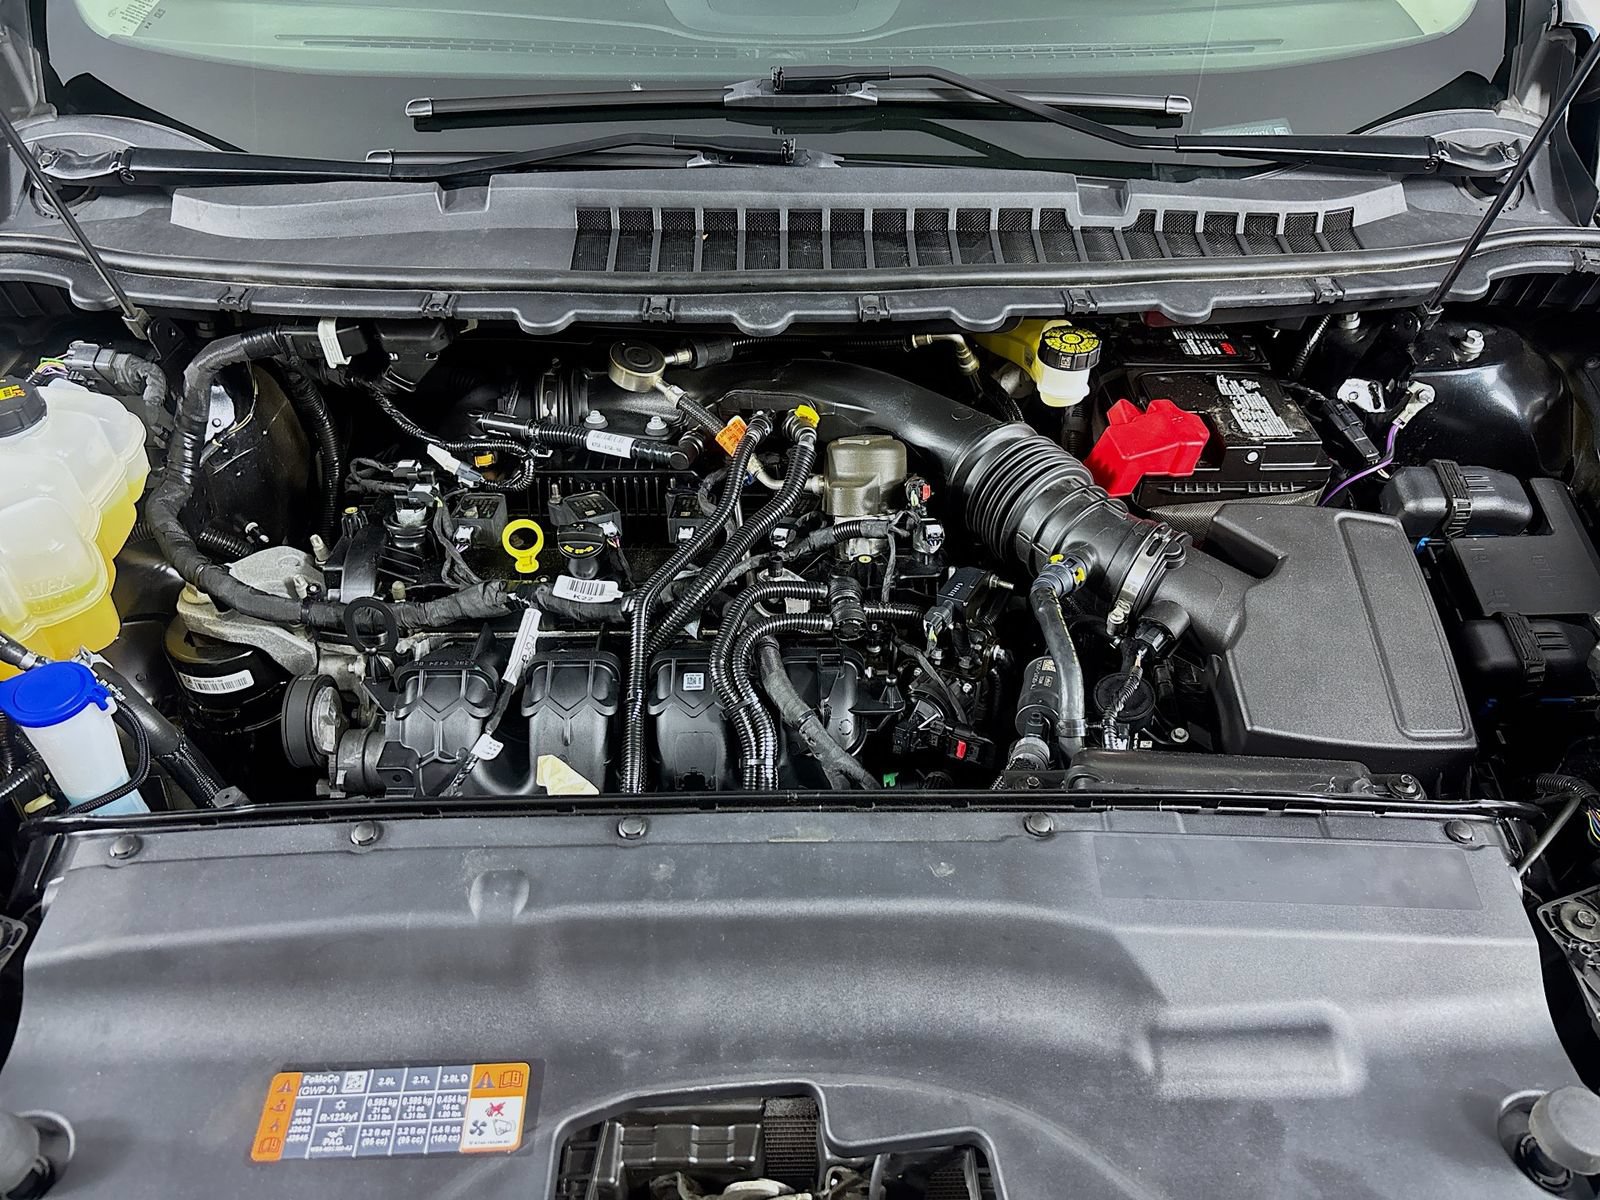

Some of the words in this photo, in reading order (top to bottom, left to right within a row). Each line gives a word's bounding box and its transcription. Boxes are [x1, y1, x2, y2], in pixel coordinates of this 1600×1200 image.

[303, 1074, 340, 1083] FoMoCo
[378, 1077, 396, 1085] 2.0L
[411, 1075, 430, 1084] 2.7L
[442, 1074, 460, 1083] 2.0L
[461, 1073, 469, 1082] D
[298, 1086, 326, 1096] (GWP
[327, 1085, 337, 1095] 4)
[388, 1097, 398, 1107] kg
[422, 1095, 432, 1105] kg
[457, 1094, 467, 1104] kg
[295, 1108, 313, 1116] SAE
[320, 1111, 359, 1122] R-1234yf
[361, 1128, 374, 1137] 3.2
[374, 1128, 381, 1136] fl
[397, 1127, 409, 1135] 3.2
[409, 1126, 416, 1135] fl
[444, 1125, 451, 1133] fl
[322, 1137, 343, 1146] PAG
[375, 1137, 388, 1146] cc)
[411, 1135, 424, 1144] cc)
[448, 1134, 460, 1143] cc)
